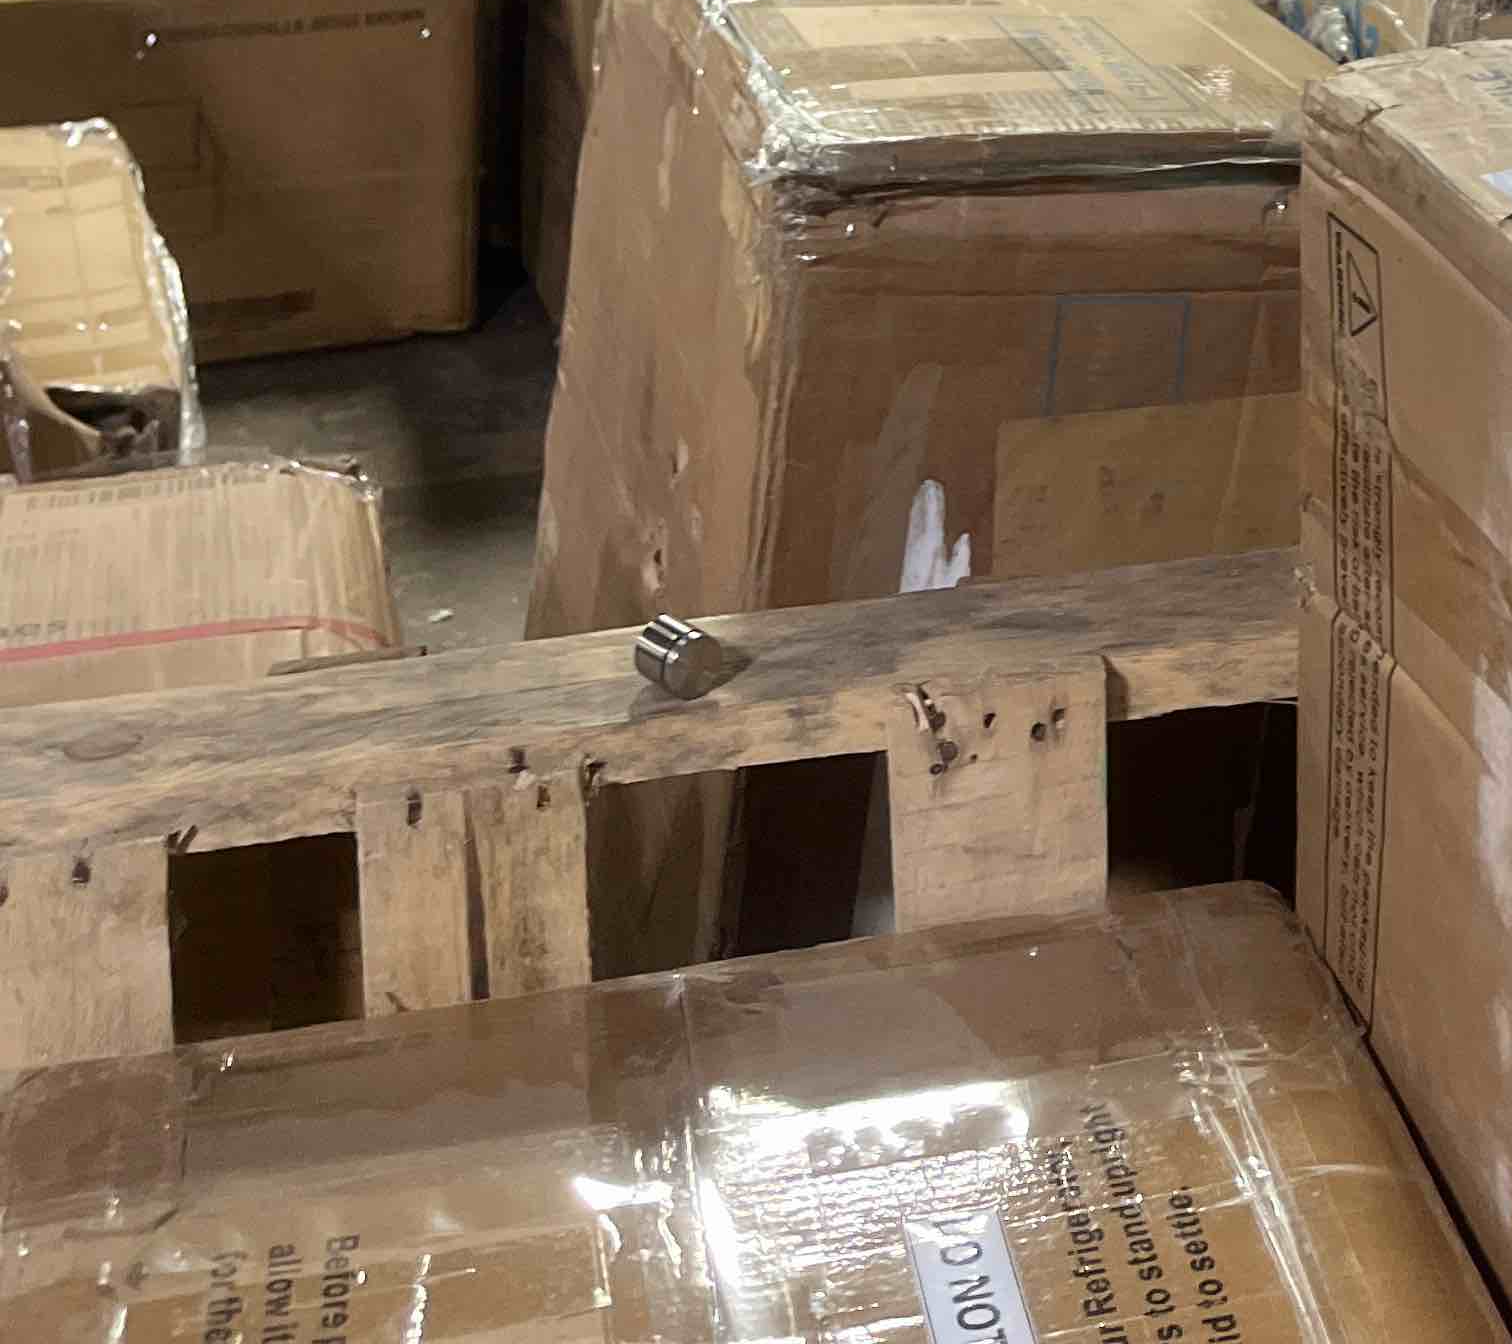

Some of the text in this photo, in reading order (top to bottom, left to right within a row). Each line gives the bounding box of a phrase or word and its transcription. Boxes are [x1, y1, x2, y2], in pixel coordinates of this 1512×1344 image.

[1108, 1200, 1164, 1281] stand
[265, 1243, 303, 1317] allow
[321, 1234, 361, 1329] Before
[1143, 1288, 1177, 1316] to
[1197, 1278, 1229, 1307] to
